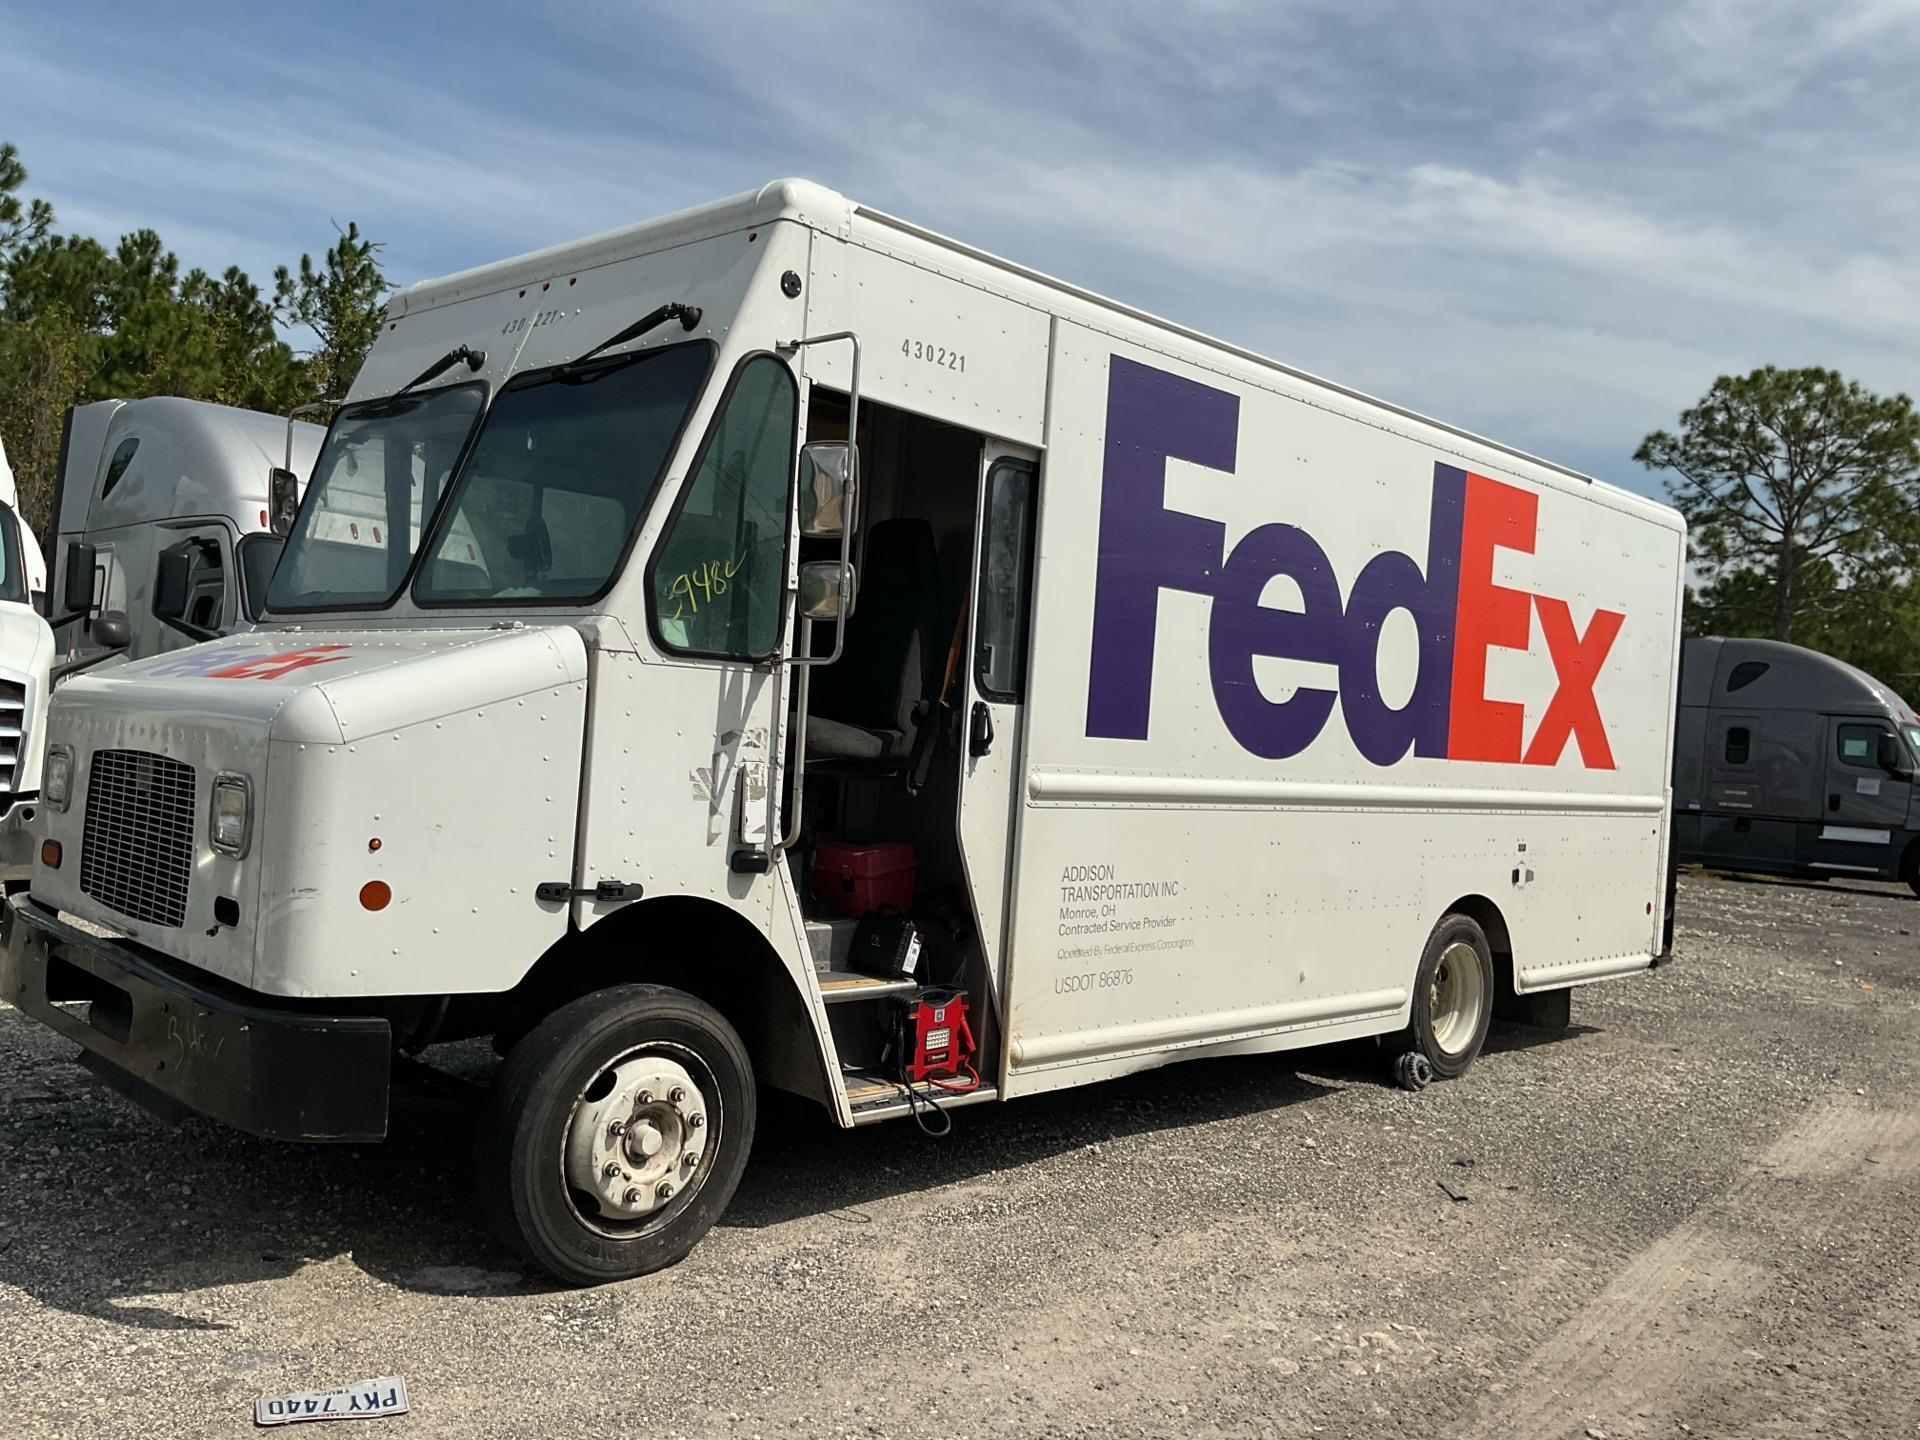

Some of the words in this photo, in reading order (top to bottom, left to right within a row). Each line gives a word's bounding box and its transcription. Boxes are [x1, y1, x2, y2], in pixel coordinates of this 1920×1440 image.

[901, 338, 965, 373] 430221
[1086, 353, 1626, 771] FedEx
[1061, 864, 1115, 882] ADDISON
[1061, 882, 1158, 903] TRANSPORTATION
[1161, 880, 1179, 897] INC
[1059, 907, 1099, 920] Monroe,
[1101, 904, 1116, 917] OH
[1058, 921, 1107, 936] Contracted
[1109, 918, 1141, 932] Service
[1143, 915, 1176, 929] Provider
[1057, 946, 1093, 961] Operated
[1094, 945, 1103, 959] By
[1104, 942, 1129, 955] Federal
[1130, 941, 1156, 954] Express
[1156, 938, 1194, 952] Corporation
[1055, 973, 1096, 994] USDOT
[1098, 968, 1133, 988] 86876
[268, 1397, 337, 1415] 7440
[349, 1388, 398, 1411] PKY
